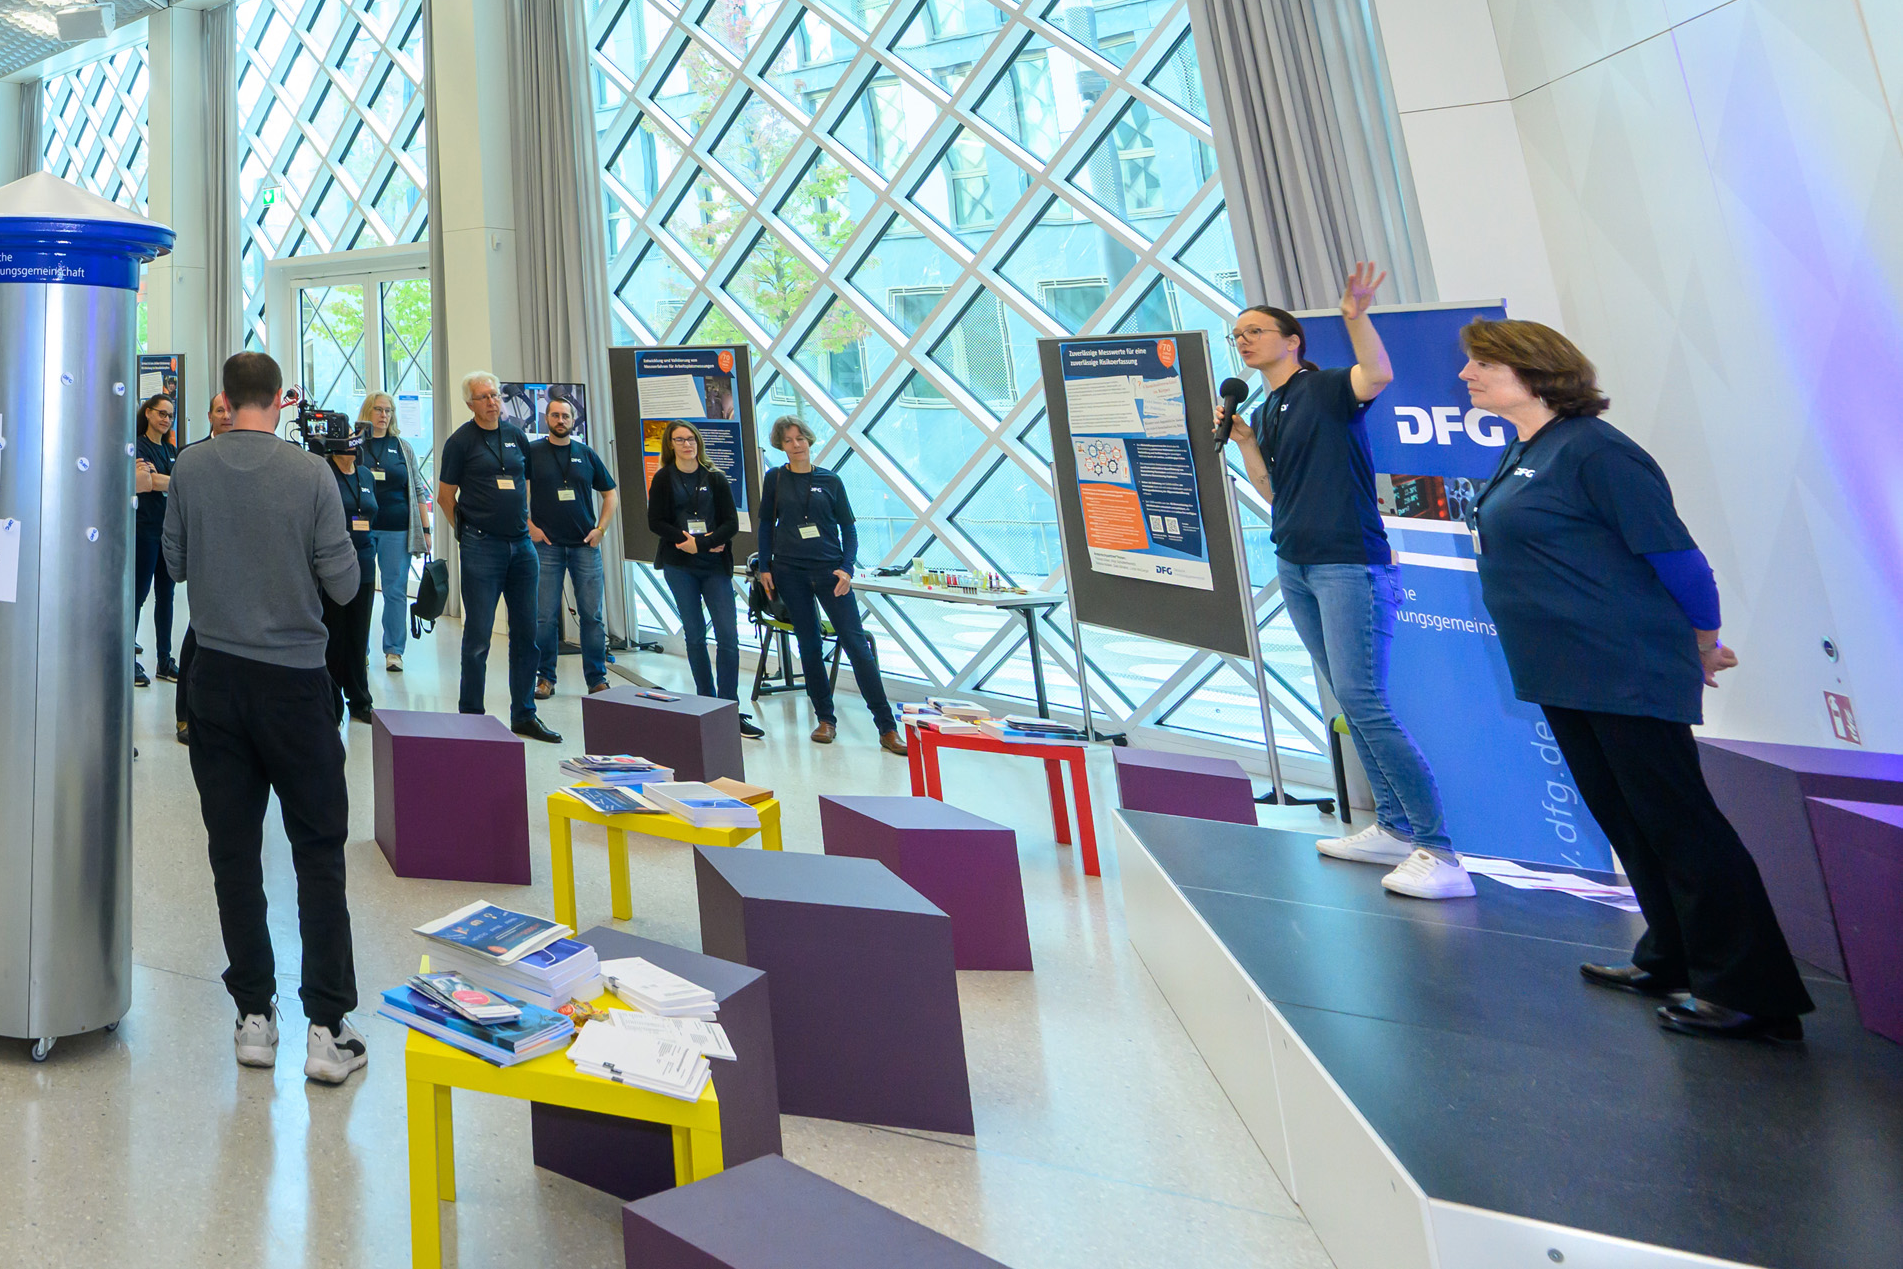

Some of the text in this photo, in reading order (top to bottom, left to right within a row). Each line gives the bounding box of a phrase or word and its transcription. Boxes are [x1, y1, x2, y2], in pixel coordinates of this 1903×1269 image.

[1069, 347, 1147, 357] Zuverlässige Messwerte für eine
[1162, 343, 1172, 352] 70
[1070, 358, 1138, 367] zuverlässige Risikoerfassung
[1394, 406, 1507, 447] DFG
[1514, 467, 1536, 478] DFG
[1156, 565, 1173, 576] DFG
